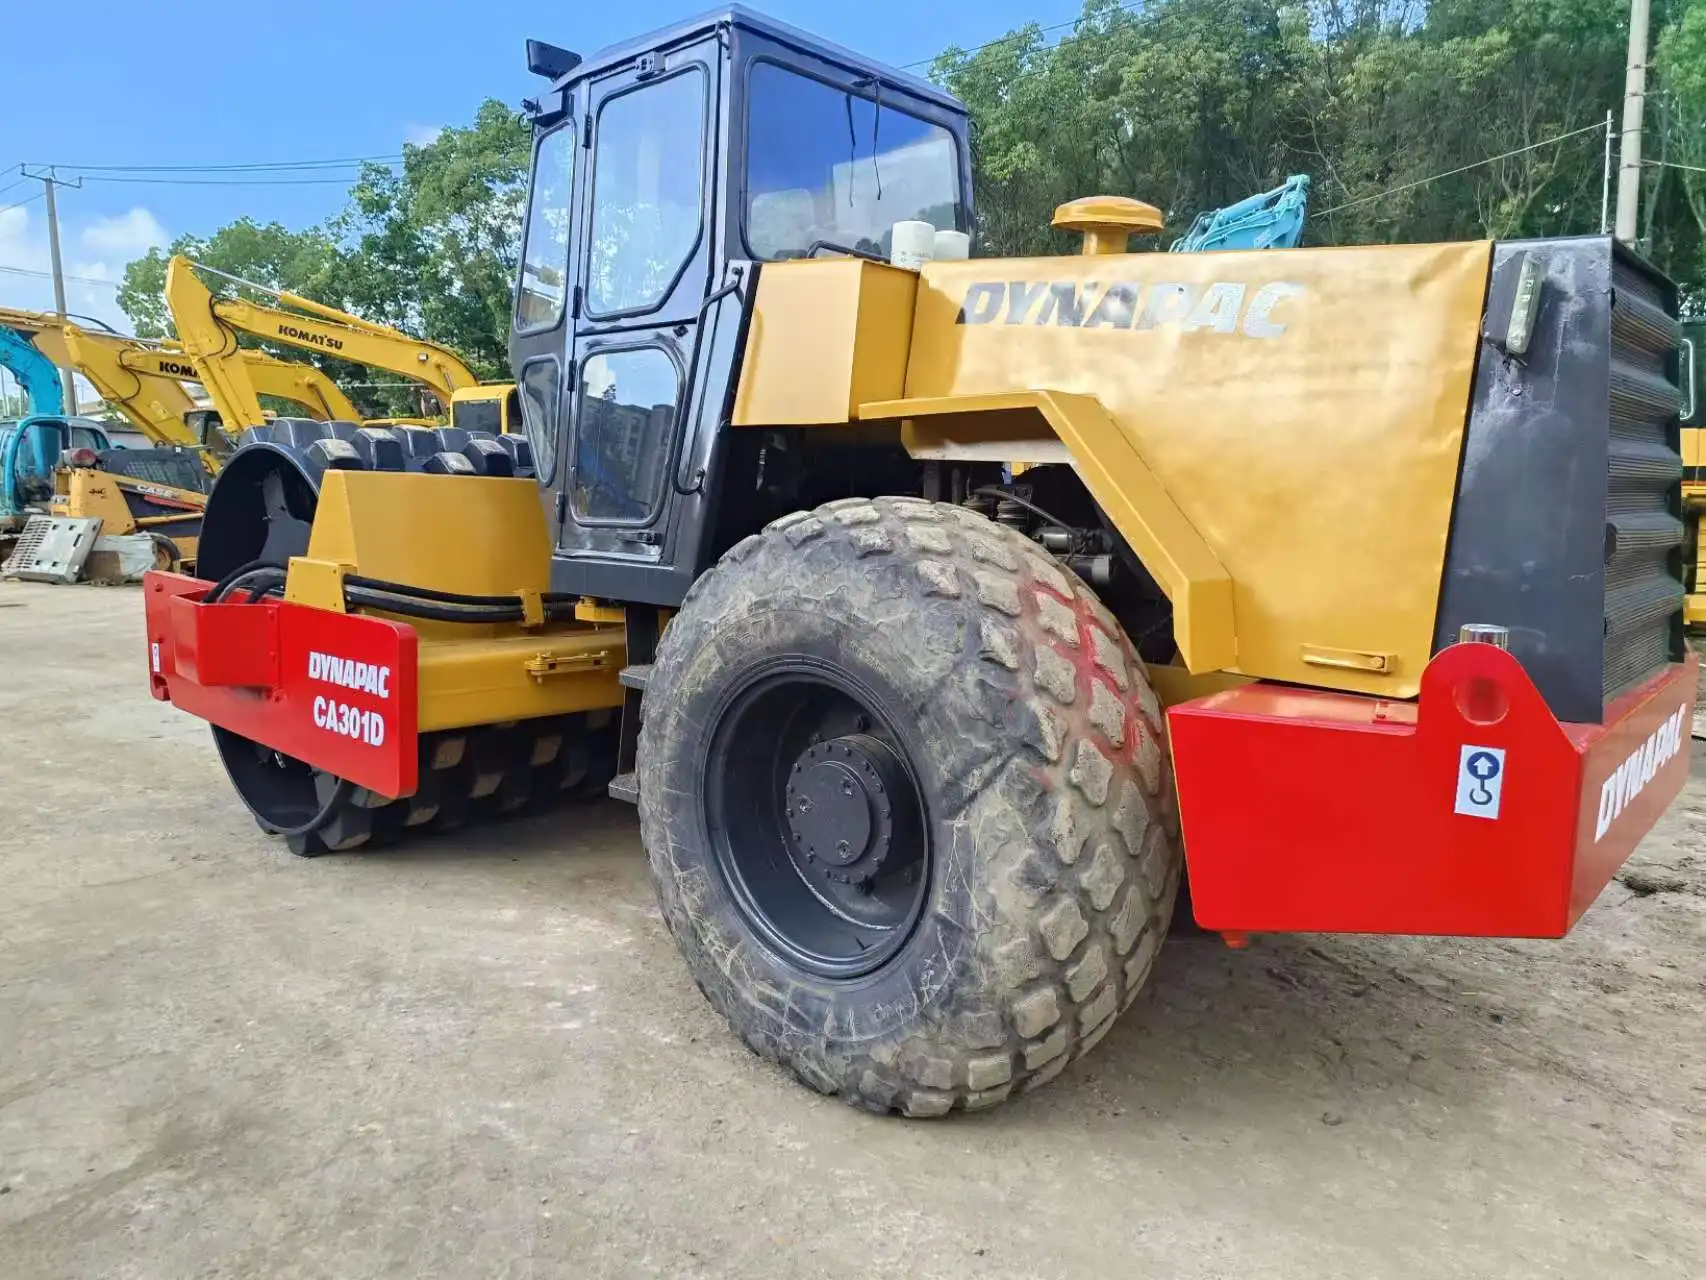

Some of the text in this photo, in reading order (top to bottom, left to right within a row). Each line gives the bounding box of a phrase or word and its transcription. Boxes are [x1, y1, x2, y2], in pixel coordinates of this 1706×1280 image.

[955, 281, 1306, 338] DYNAPAC
[278, 325, 344, 349] KOMATSU
[309, 652, 390, 697] DYNAPAC
[314, 696, 384, 745] CA301D
[1594, 703, 1686, 843] DYNAPAC
